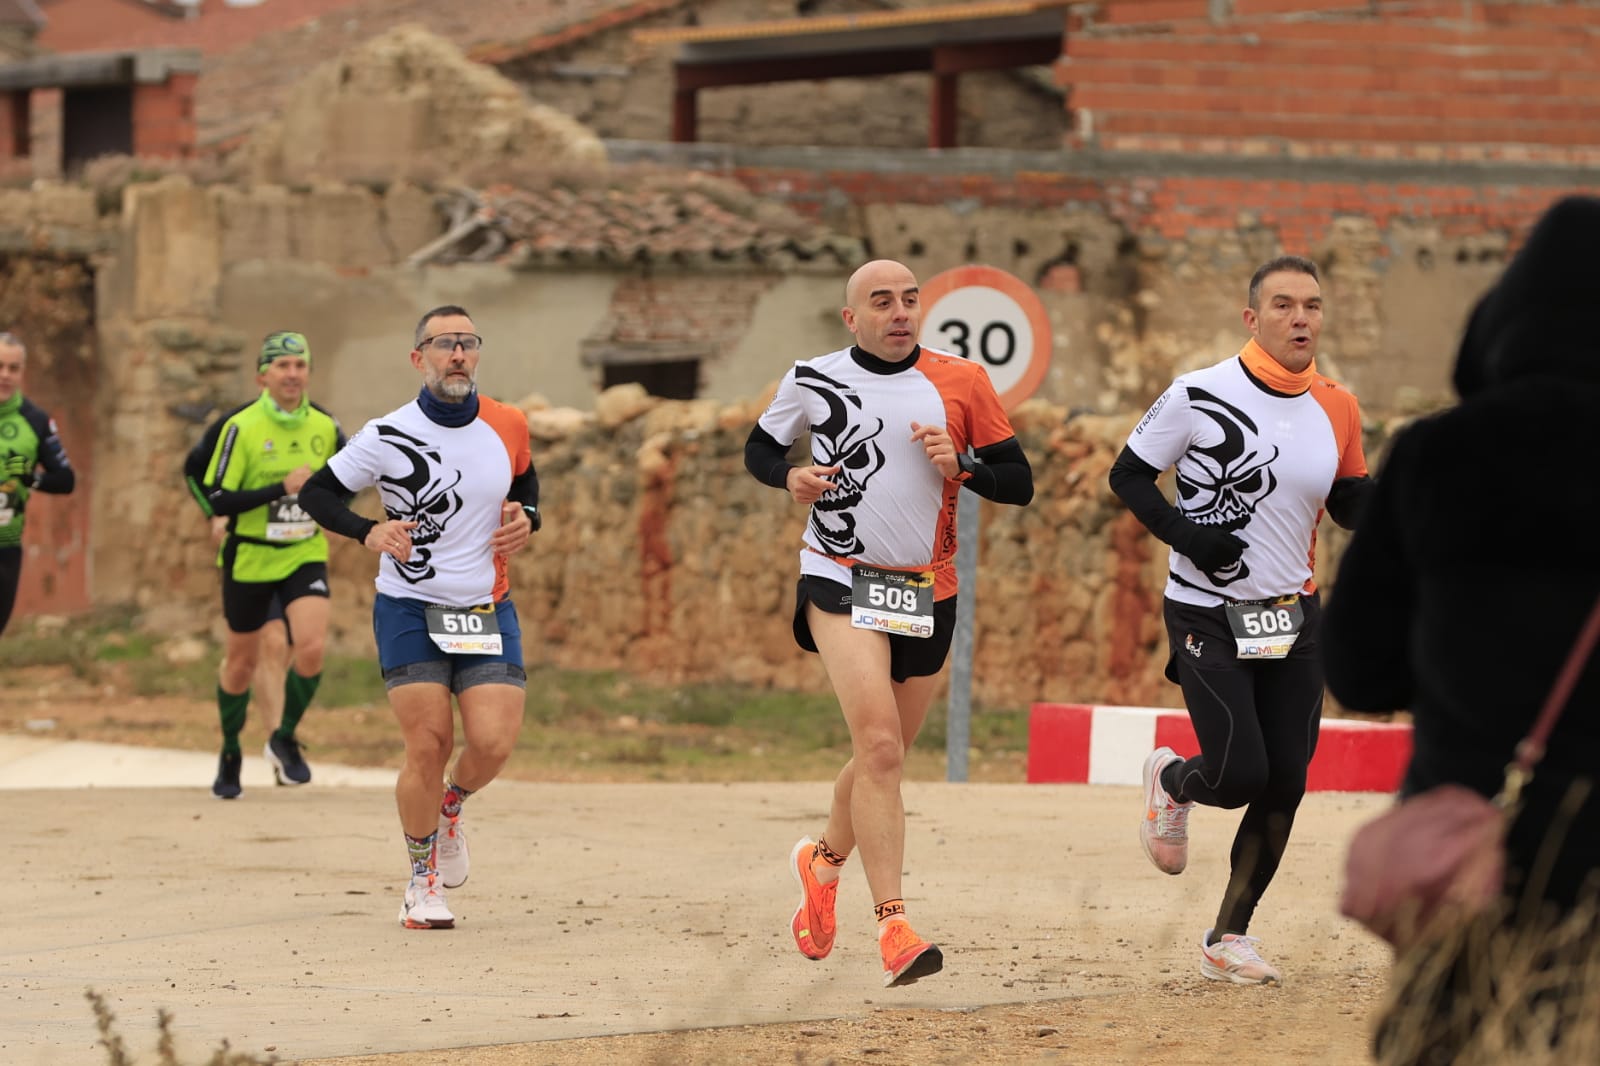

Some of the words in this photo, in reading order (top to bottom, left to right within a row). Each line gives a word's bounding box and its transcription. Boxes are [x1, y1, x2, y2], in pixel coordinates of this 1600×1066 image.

[938, 319, 1015, 366] 30
[869, 583, 917, 612] 509
[442, 614, 483, 633] 510
[855, 615, 931, 635] JOMISAGA
[1242, 609, 1292, 635] 508
